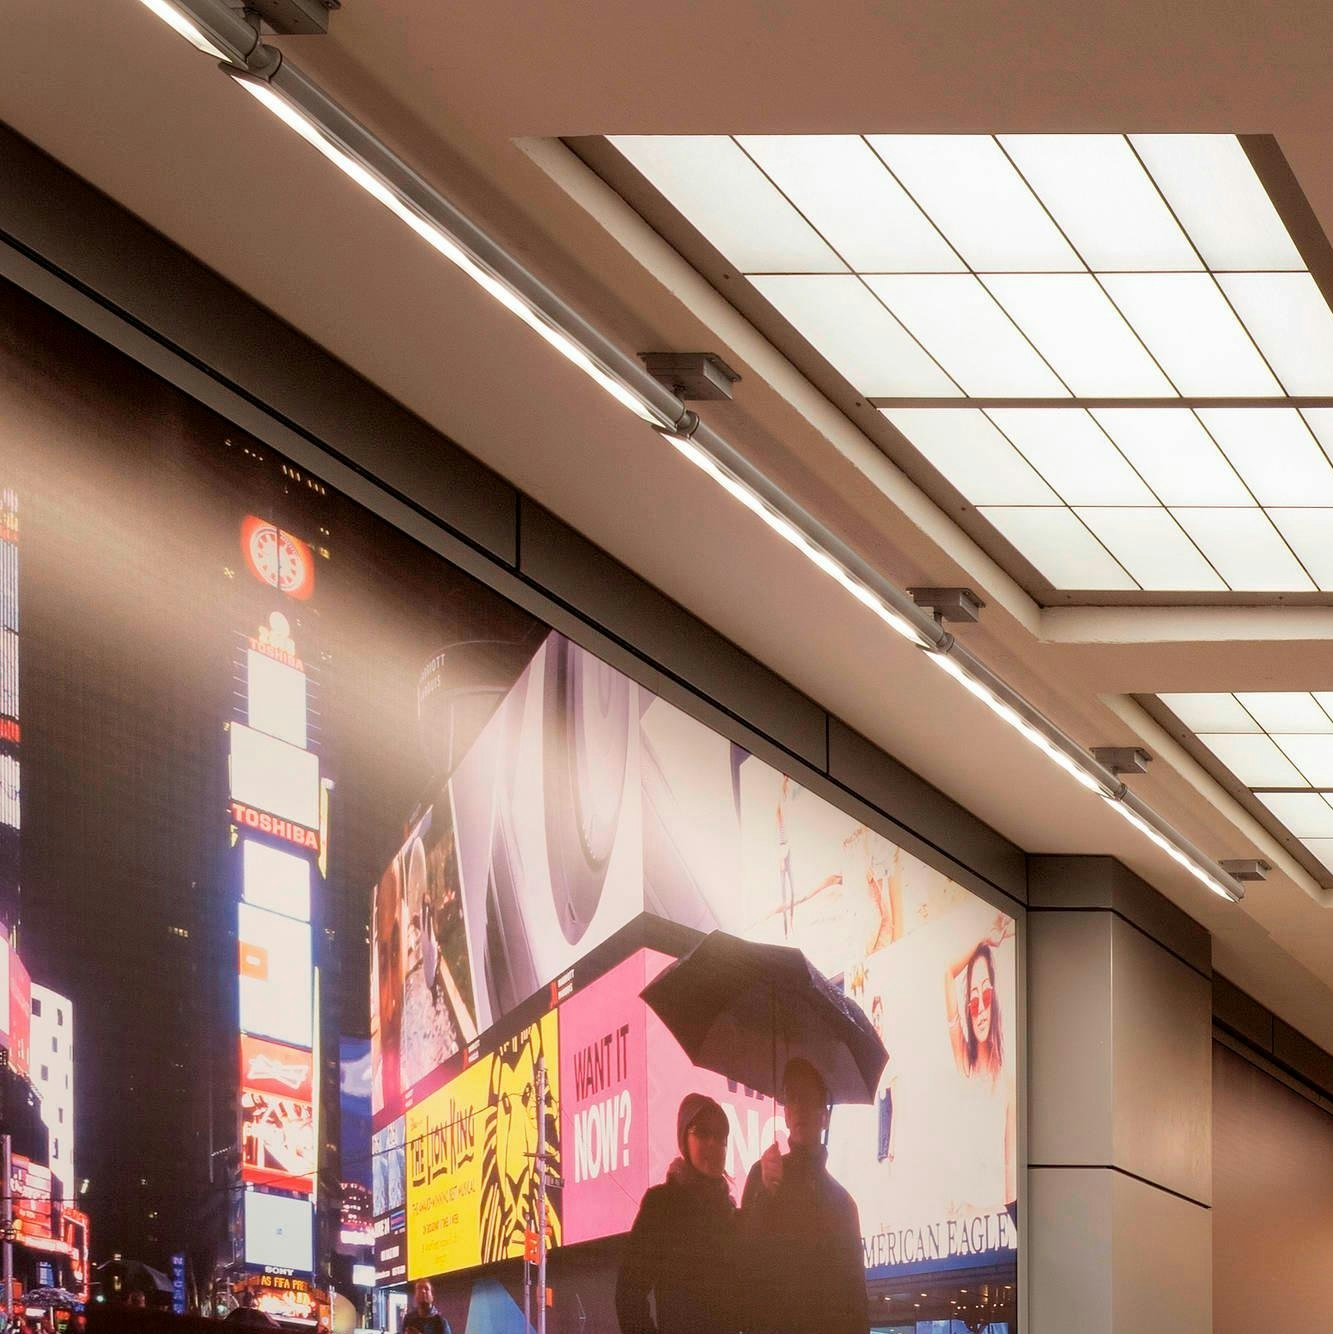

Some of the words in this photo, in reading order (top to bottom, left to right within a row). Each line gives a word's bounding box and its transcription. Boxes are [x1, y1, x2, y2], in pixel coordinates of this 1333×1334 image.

[232, 803, 319, 851] TOSHIBA
[573, 1033, 613, 1101] WANT
[616, 1024, 629, 1082] IT
[411, 1134, 424, 1180] THE
[426, 1115, 447, 1185] LION
[450, 1098, 475, 1175] KING
[573, 1089, 632, 1184] NOW?
[861, 1223, 940, 1267] MERICAN
[947, 1212, 1011, 1256] EAGLE
[261, 1275, 272, 1288] AS
[274, 1277, 290, 1290] FIFA
[265, 1266, 294, 1276] SONY
